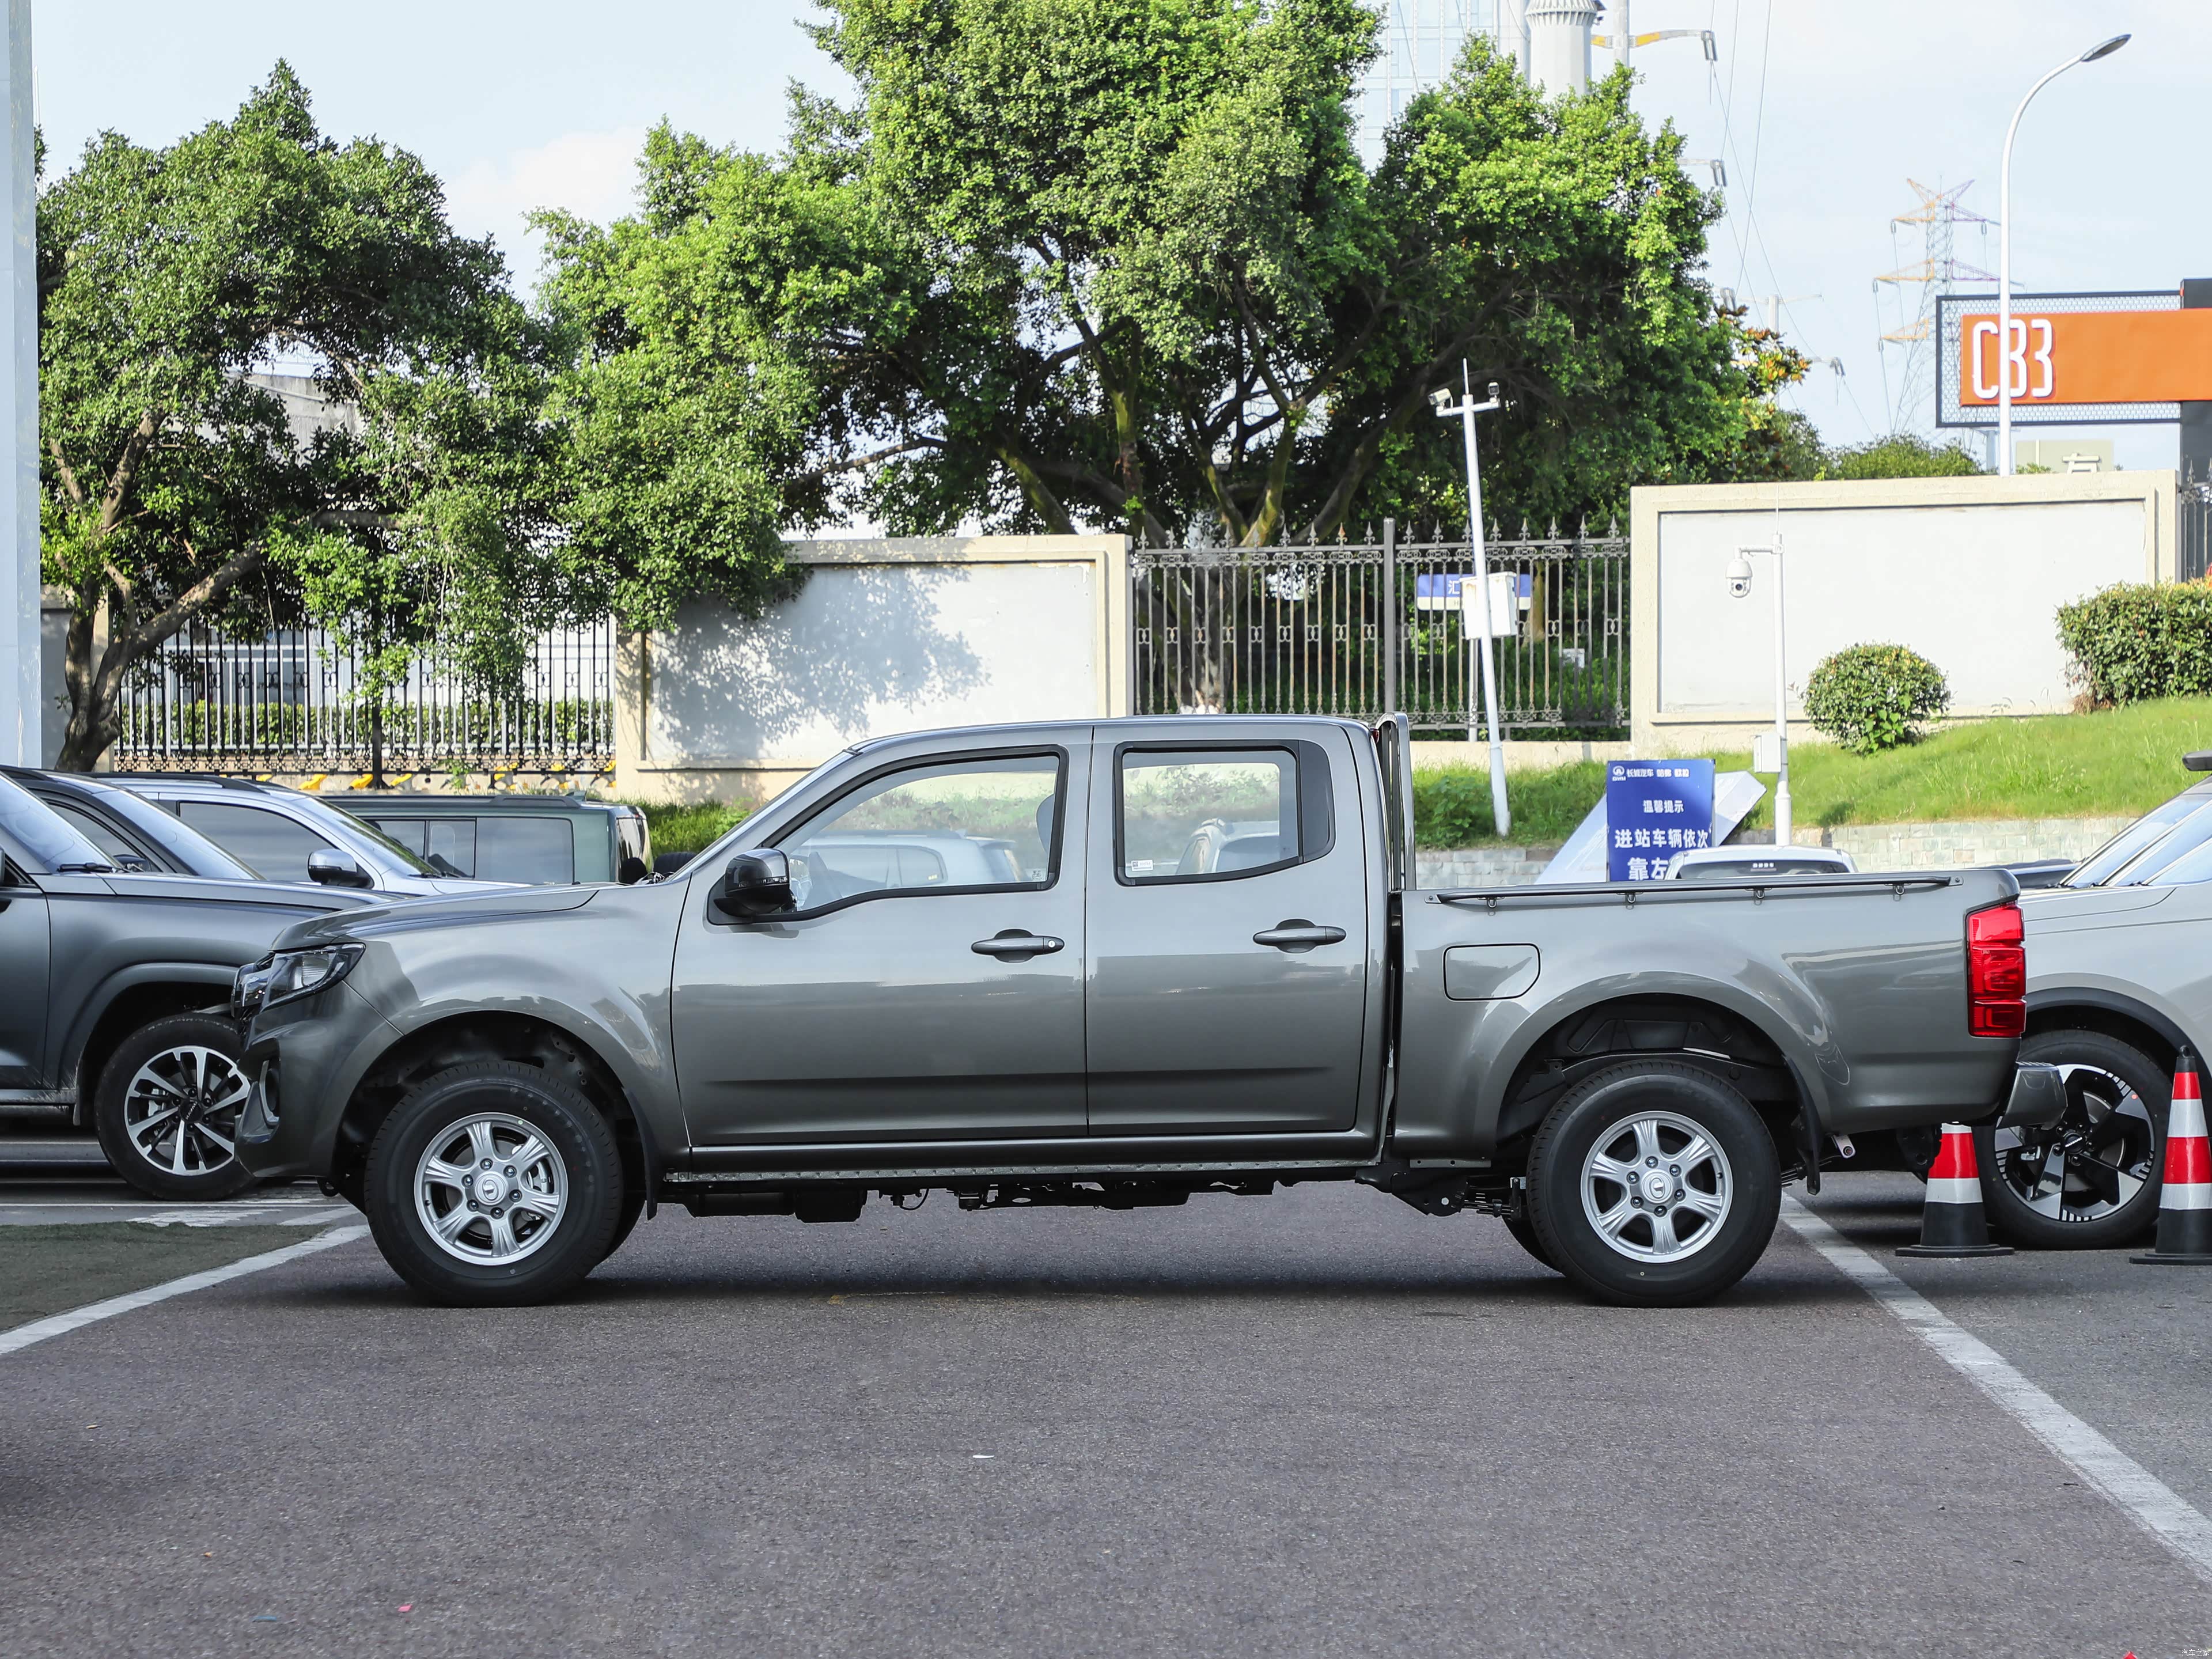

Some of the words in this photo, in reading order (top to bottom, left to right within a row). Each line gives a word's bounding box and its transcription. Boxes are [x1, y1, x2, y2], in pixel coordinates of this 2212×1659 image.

[1643, 800, 1684, 813] 温馨提示
[1615, 828, 1709, 849] 进站车辆依次
[1627, 857, 1669, 880] 靠左
